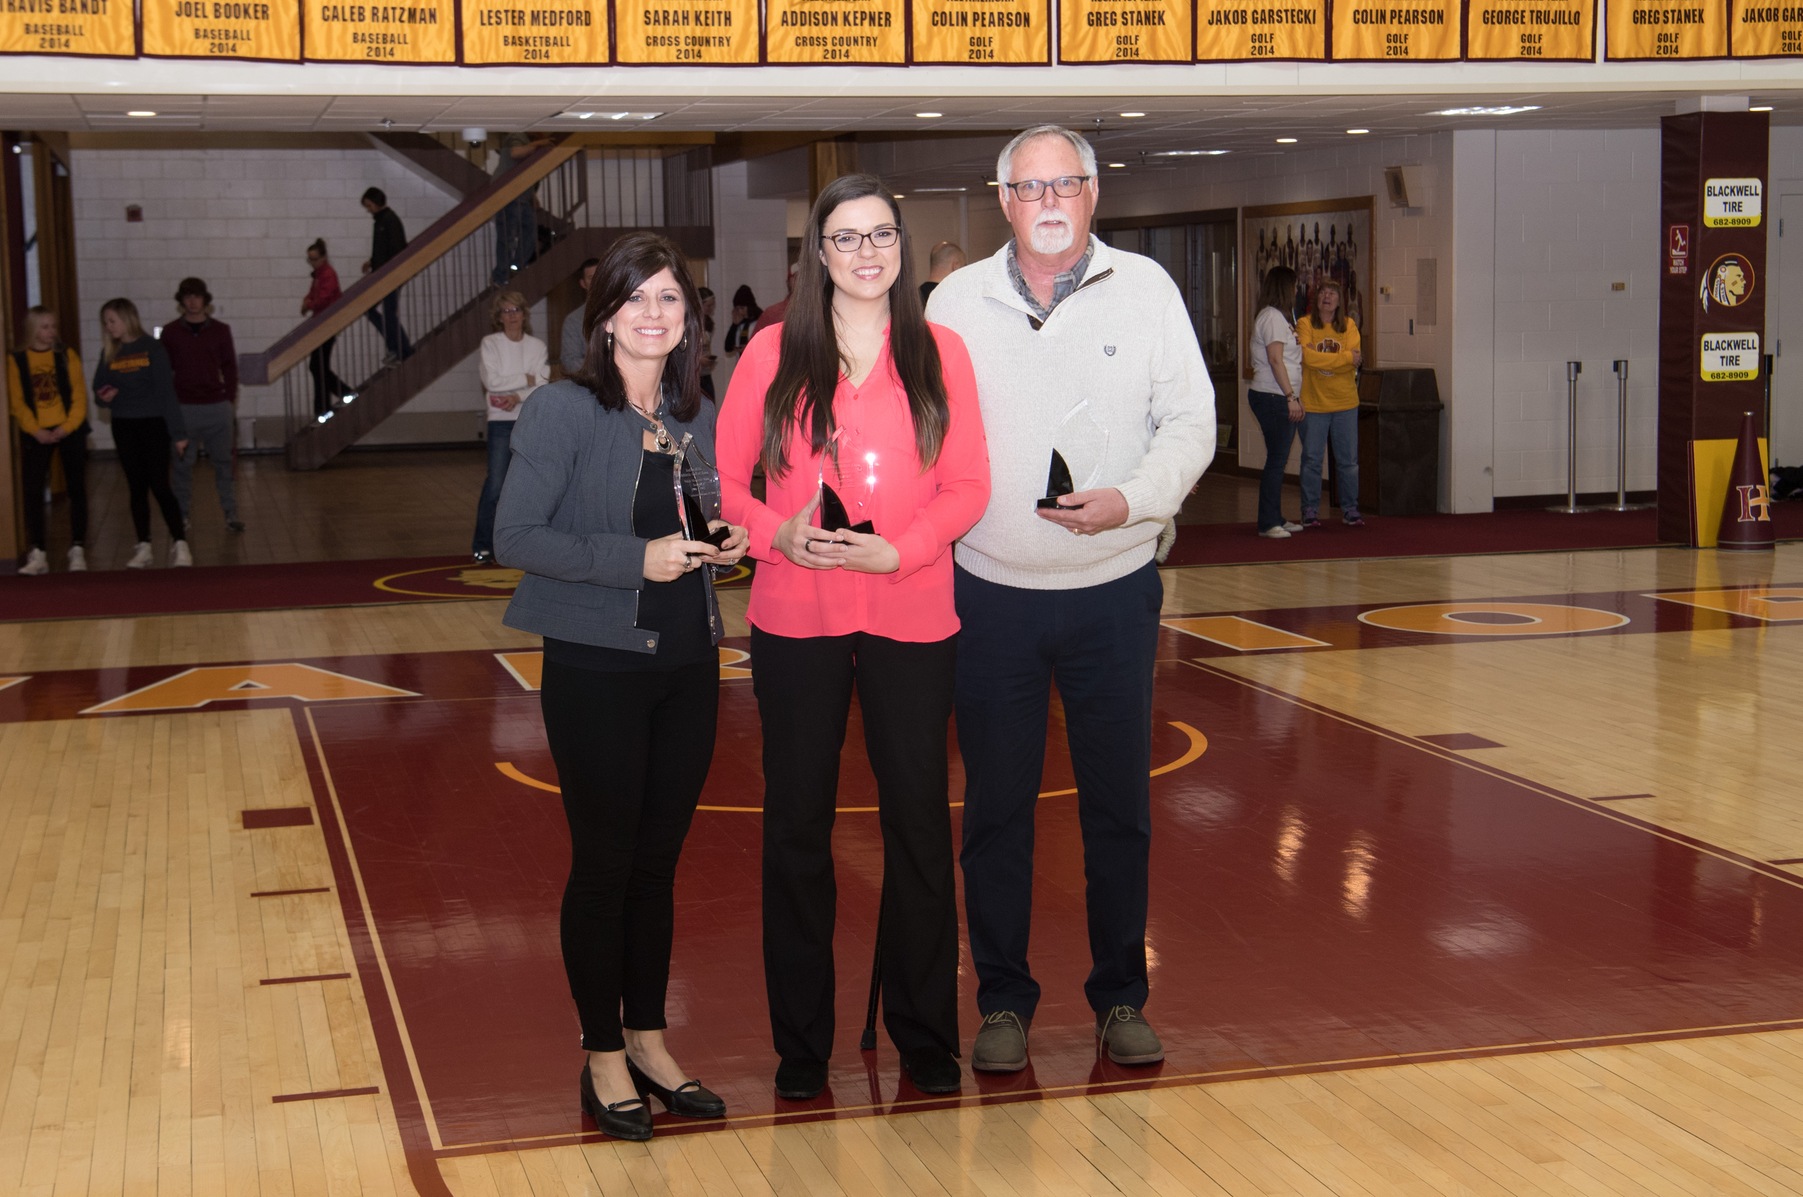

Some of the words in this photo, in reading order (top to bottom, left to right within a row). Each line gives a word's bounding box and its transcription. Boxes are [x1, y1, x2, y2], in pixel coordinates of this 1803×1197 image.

[0, 0, 53, 13] RAVIS
[175, 1, 208, 19] JOEL
[213, 2, 269, 20] BOOKER
[322, 5, 366, 22] CALEB
[371, 6, 437, 24] RATZMAN
[480, 9, 525, 26] LESTER
[530, 10, 591, 27] MEDFORD
[644, 10, 689, 26] SARAH
[694, 10, 732, 27] KEITH
[781, 10, 838, 27] ADDISON
[843, 10, 891, 27] KEPNER
[931, 11, 968, 27] COLIN
[972, 11, 1030, 28] PEARSON
[1087, 11, 1117, 27] GREG
[1121, 10, 1165, 26] STANEK
[1208, 9, 1248, 26] JAKOB
[1251, 9, 1316, 25] GARSTECKI
[1353, 9, 1386, 25] COLIN
[1390, 9, 1444, 25] PEARSON
[1482, 9, 1526, 25] GEORGE
[1529, 9, 1581, 26] TRUJILLO
[1633, 9, 1660, 25] GREG
[1662, 8, 1704, 25] STANEK
[1742, 7, 1779, 23] JAKOB
[24, 23, 84, 36] BASEBALL
[194, 28, 251, 41] BASEBALL
[1781, 30, 1802, 41] GOLF
[39, 38, 70, 49] 2014
[353, 32, 408, 45] BASEBALL
[503, 35, 570, 47] BASKETBALL
[645, 35, 680, 47] CROSS
[685, 35, 731, 47] COUNTRY
[795, 36, 828, 47] CROSS
[831, 36, 878, 47] COUNTRY
[969, 36, 993, 48] GOLF
[1116, 35, 1139, 46] GOLF
[1251, 33, 1274, 44] GOLF
[1386, 33, 1409, 44] GOLF
[1520, 33, 1543, 44] GOLF
[1657, 33, 1679, 43] GOLF
[209, 42, 237, 54] 2014
[366, 46, 395, 58] 2014
[1116, 47, 1139, 58] 2014
[1250, 45, 1275, 56] 2014
[1386, 45, 1409, 56] 2014
[1520, 45, 1542, 56] 2014
[1656, 44, 1679, 55] 2014
[1782, 42, 1802, 52] 2014
[524, 49, 550, 60] 2014
[676, 48, 702, 60] 2014
[823, 49, 850, 60] 2014
[968, 49, 994, 60] 2014
[1707, 185, 1759, 197] BLACKWELL
[1723, 201, 1743, 212] TIRE
[1713, 218, 1752, 226] 682-8909
[1703, 339, 1757, 351] BLACKWELL
[1720, 355, 1740, 366] TIRE
[1710, 371, 1749, 380] 682-8909
[1736, 485, 1770, 522] H
